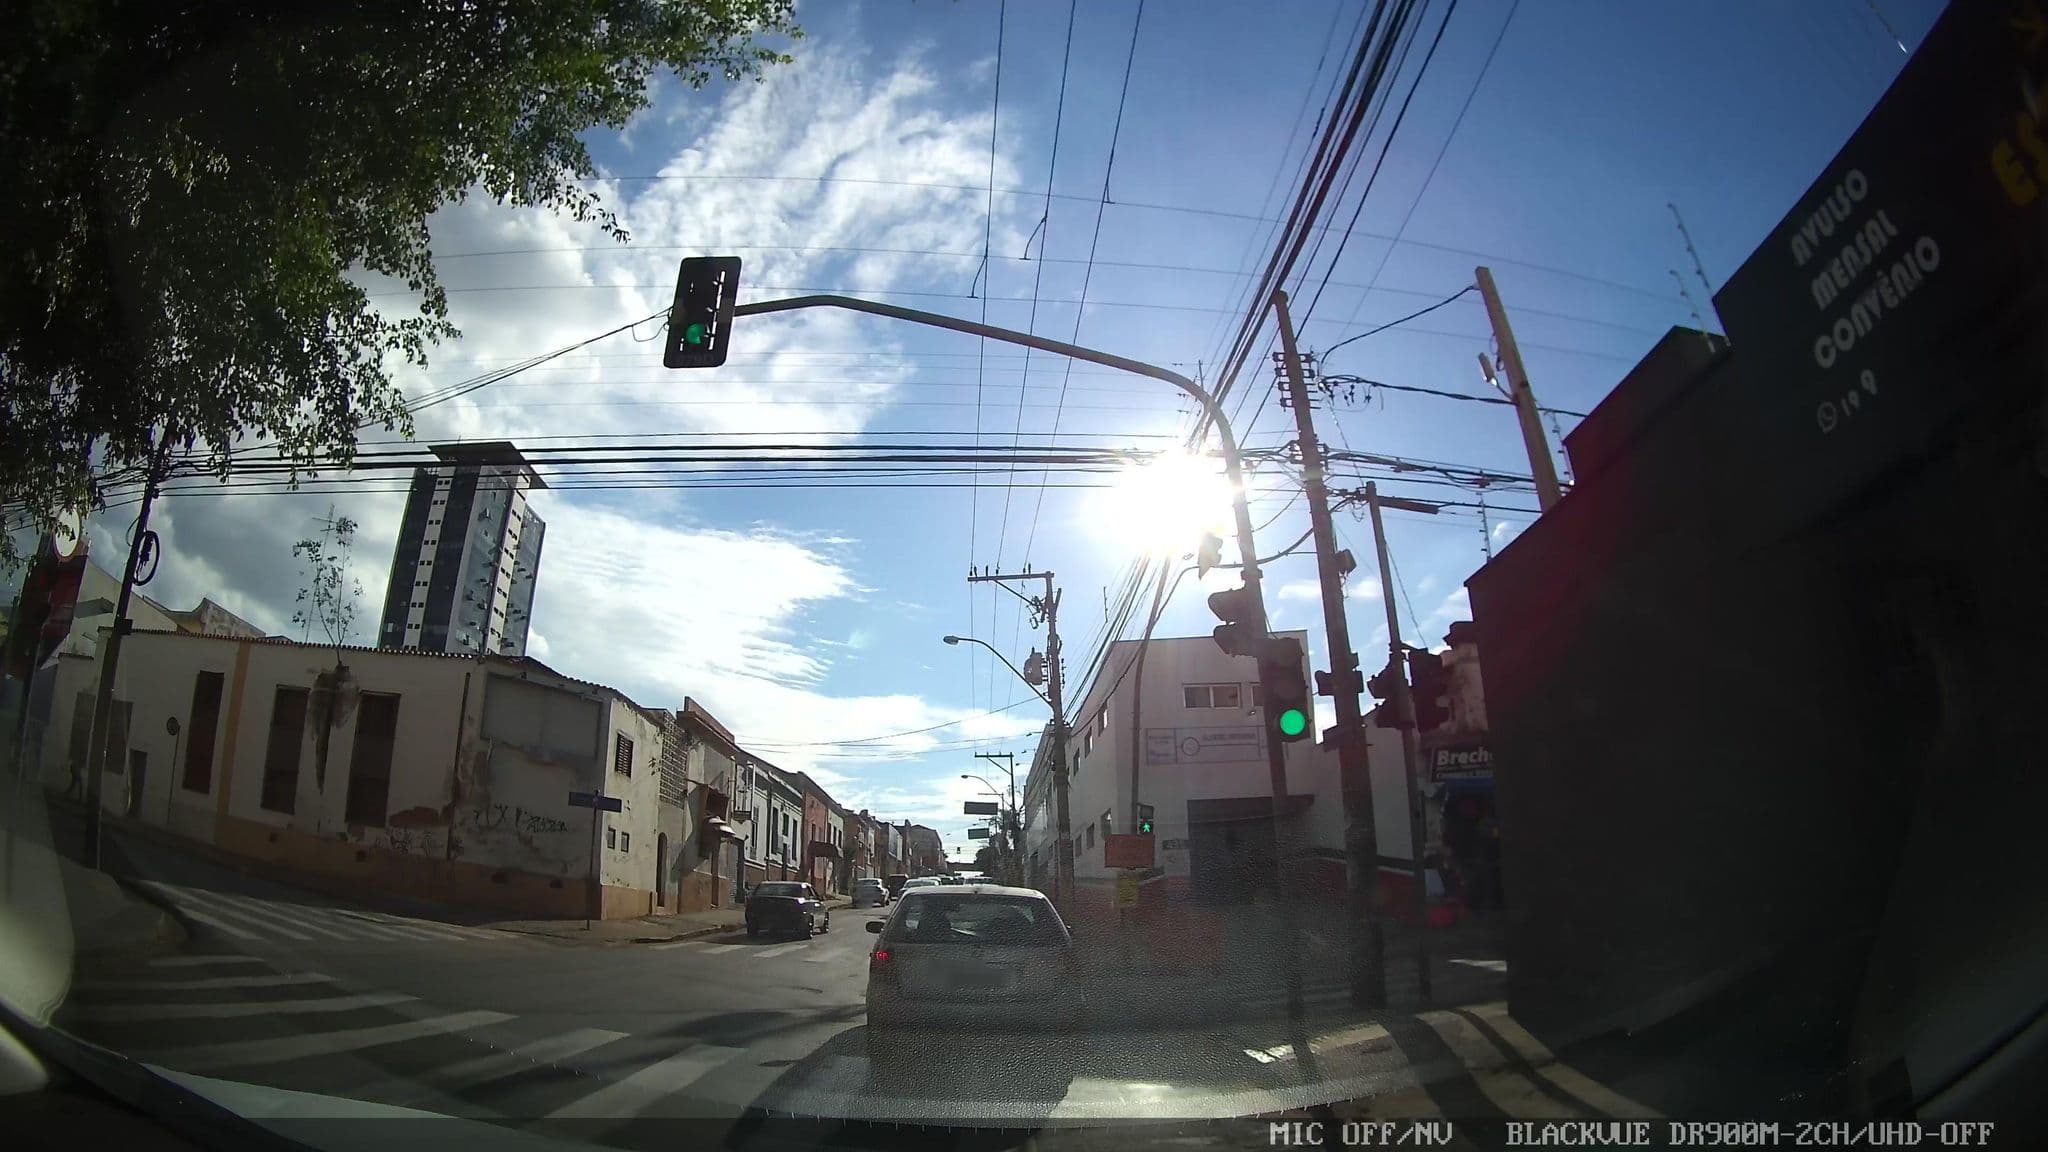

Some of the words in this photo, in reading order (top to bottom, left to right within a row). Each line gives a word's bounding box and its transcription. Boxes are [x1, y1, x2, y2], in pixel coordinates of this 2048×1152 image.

[1791, 168, 1868, 266] AVULSO
[1811, 209, 1898, 311] MENSAL
[1815, 235, 1940, 369] CONVÊNIO
